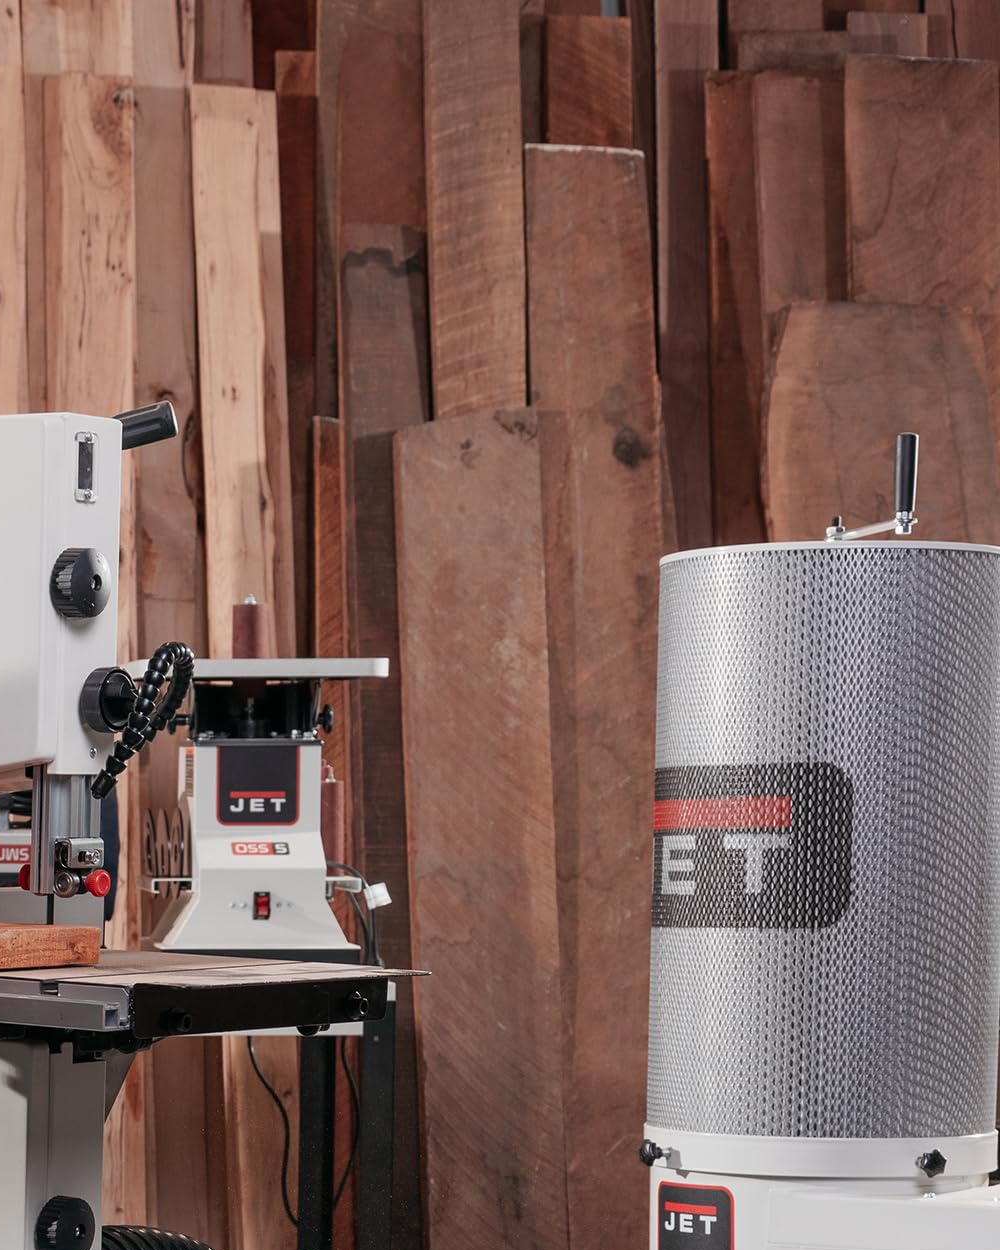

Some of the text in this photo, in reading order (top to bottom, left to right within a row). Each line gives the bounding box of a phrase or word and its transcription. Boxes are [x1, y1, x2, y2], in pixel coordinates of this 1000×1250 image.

[229, 798, 286, 813] JET
[234, 843, 270, 854] OSS
[661, 833, 792, 896] ET
[664, 1211, 717, 1235] JET
